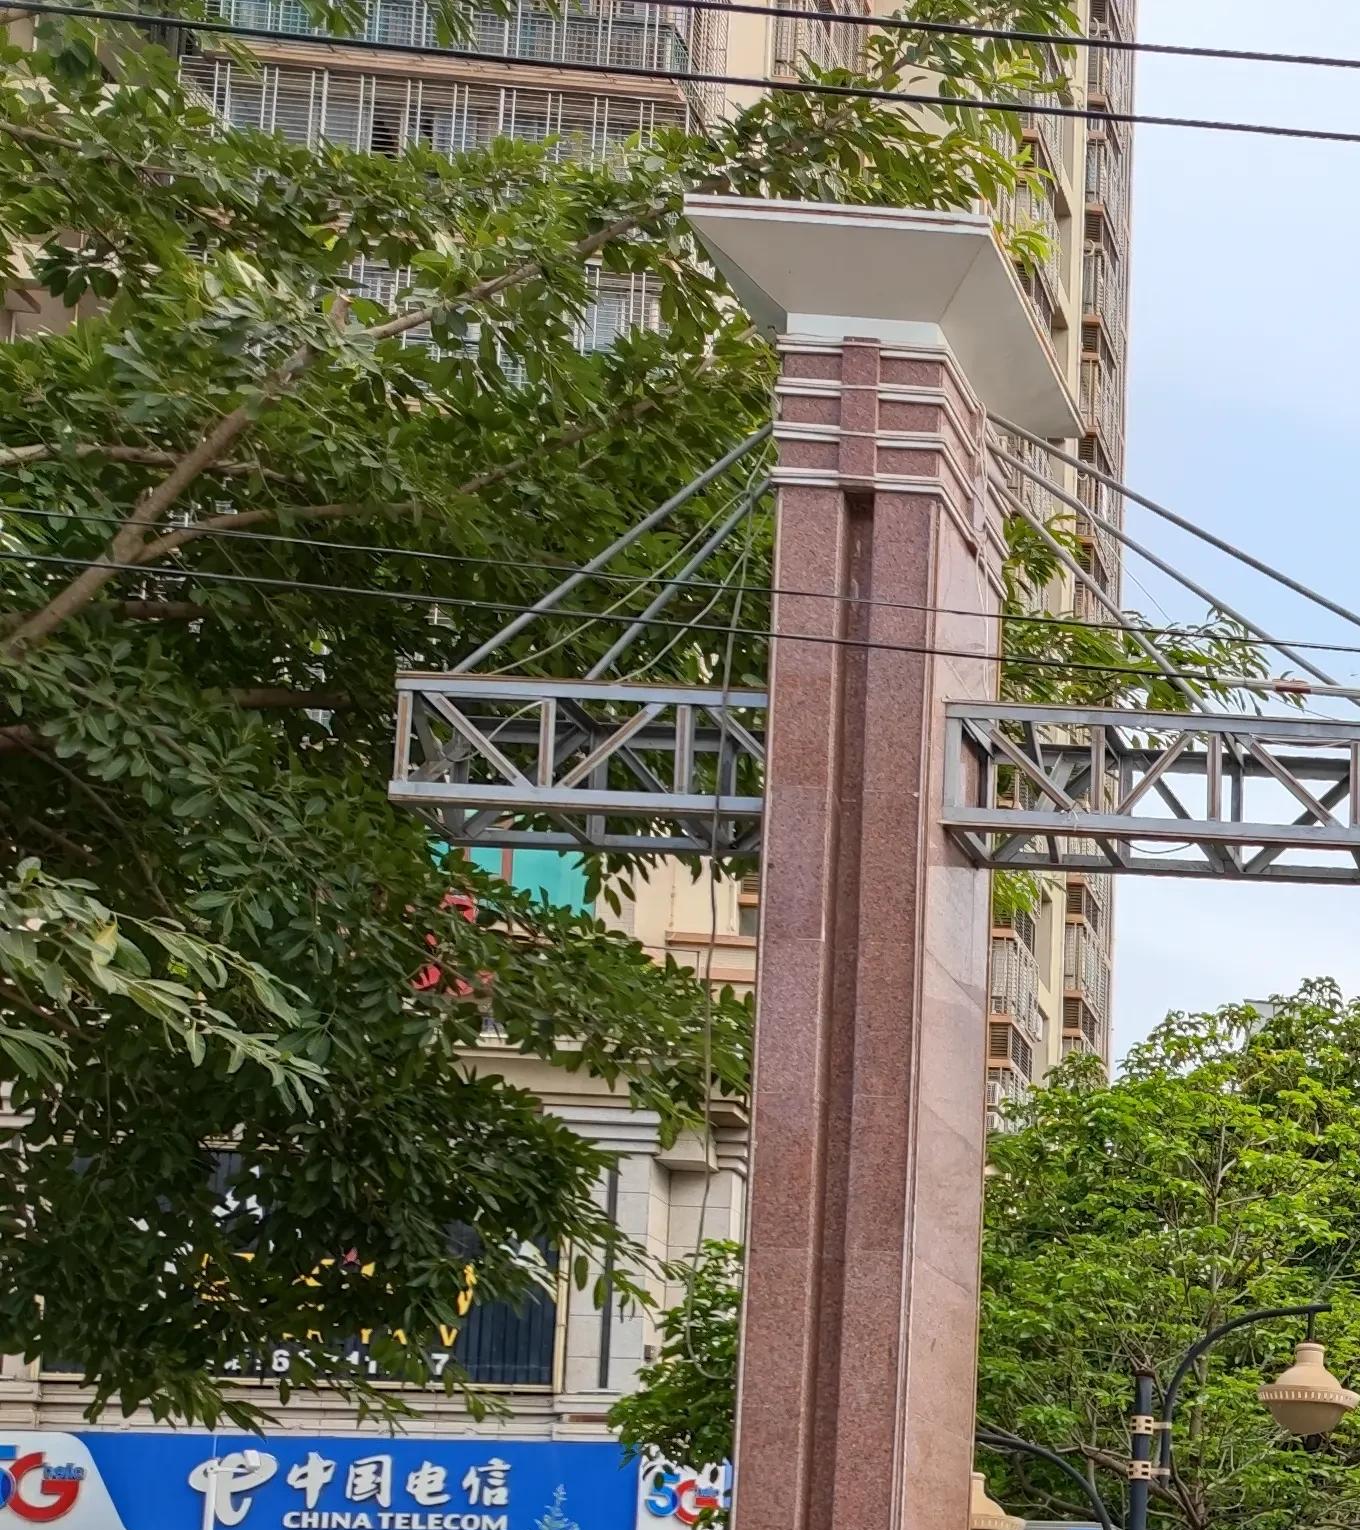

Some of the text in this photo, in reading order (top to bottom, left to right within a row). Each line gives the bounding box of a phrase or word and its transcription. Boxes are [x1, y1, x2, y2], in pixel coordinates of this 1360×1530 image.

[287, 1451, 511, 1509] 中国电信
[283, 1511, 370, 1530] CHINA
